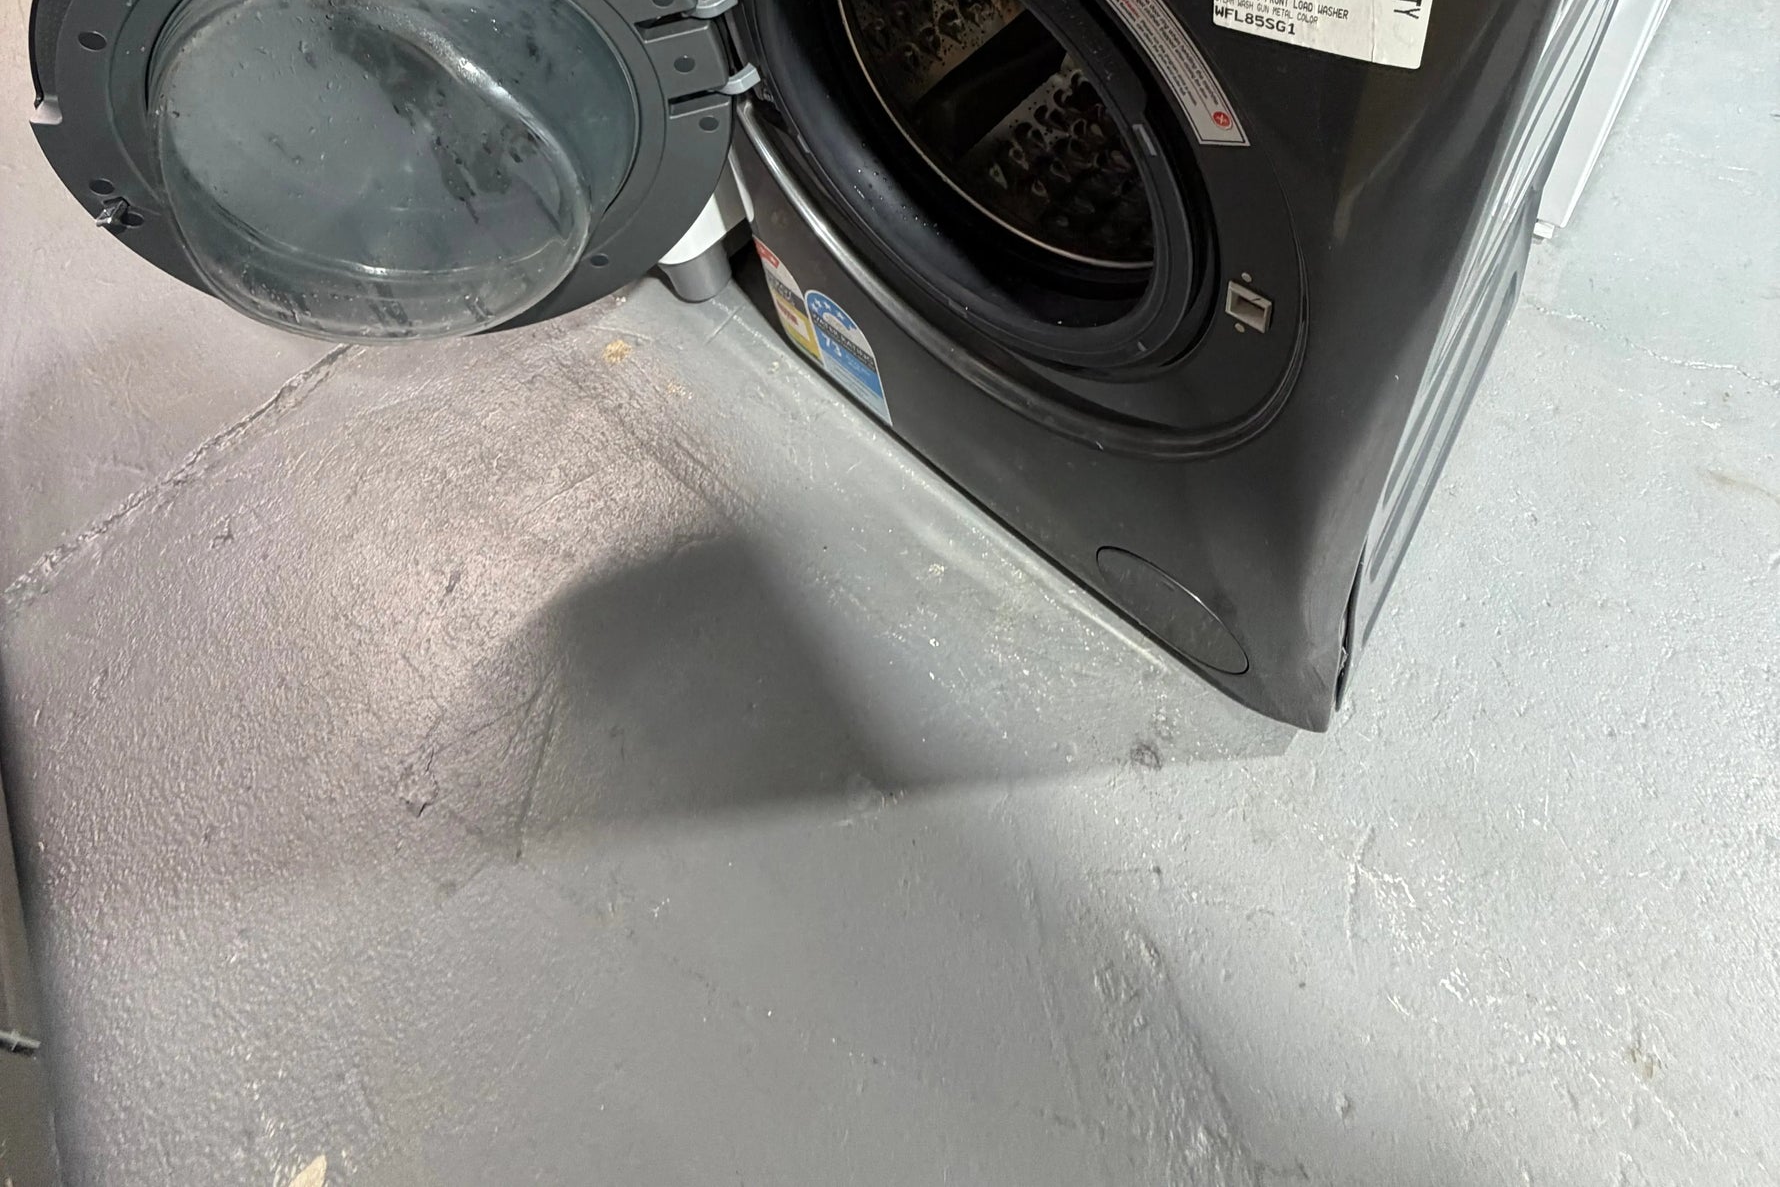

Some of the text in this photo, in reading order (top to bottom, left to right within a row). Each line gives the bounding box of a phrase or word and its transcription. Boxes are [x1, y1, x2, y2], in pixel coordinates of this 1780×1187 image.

[1215, 5, 1296, 35] WFL85SG1
[1256, 3, 1269, 13] GUN
[1272, 7, 1294, 19] METAL
[1293, 0, 1314, 12] LOAD
[1317, 5, 1349, 20] WASHER
